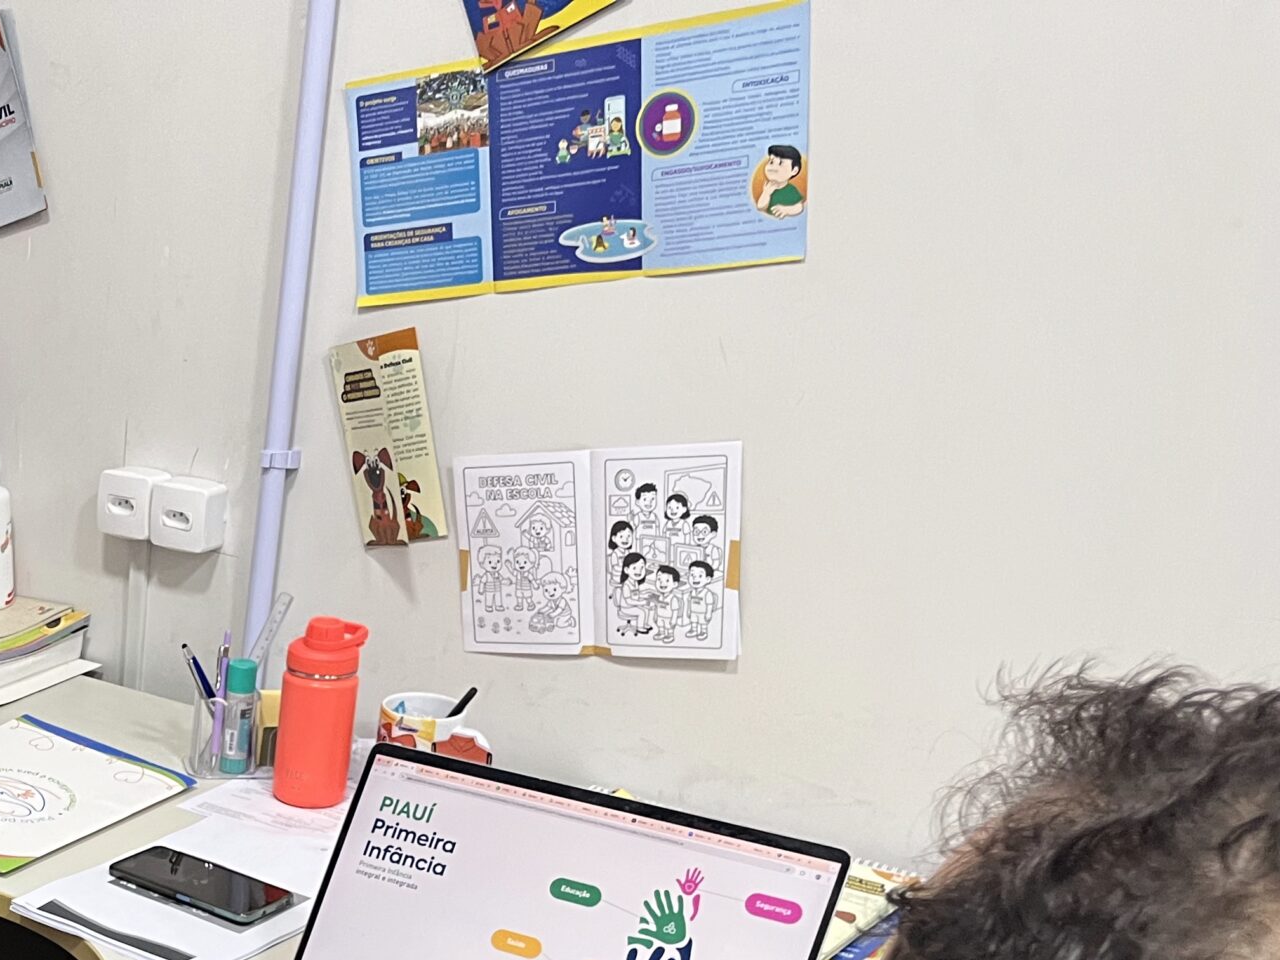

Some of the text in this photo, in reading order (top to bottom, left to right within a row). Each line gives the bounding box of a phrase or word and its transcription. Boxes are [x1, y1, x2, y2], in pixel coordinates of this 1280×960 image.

[478, 473, 559, 489] DEFESA CIVIL
[485, 486, 553, 501] NA ESCOLA
[379, 795, 437, 823] PIAUÍ
[370, 817, 457, 854] Primeira
[362, 840, 447, 876] Infância
[559, 884, 591, 899] Educação
